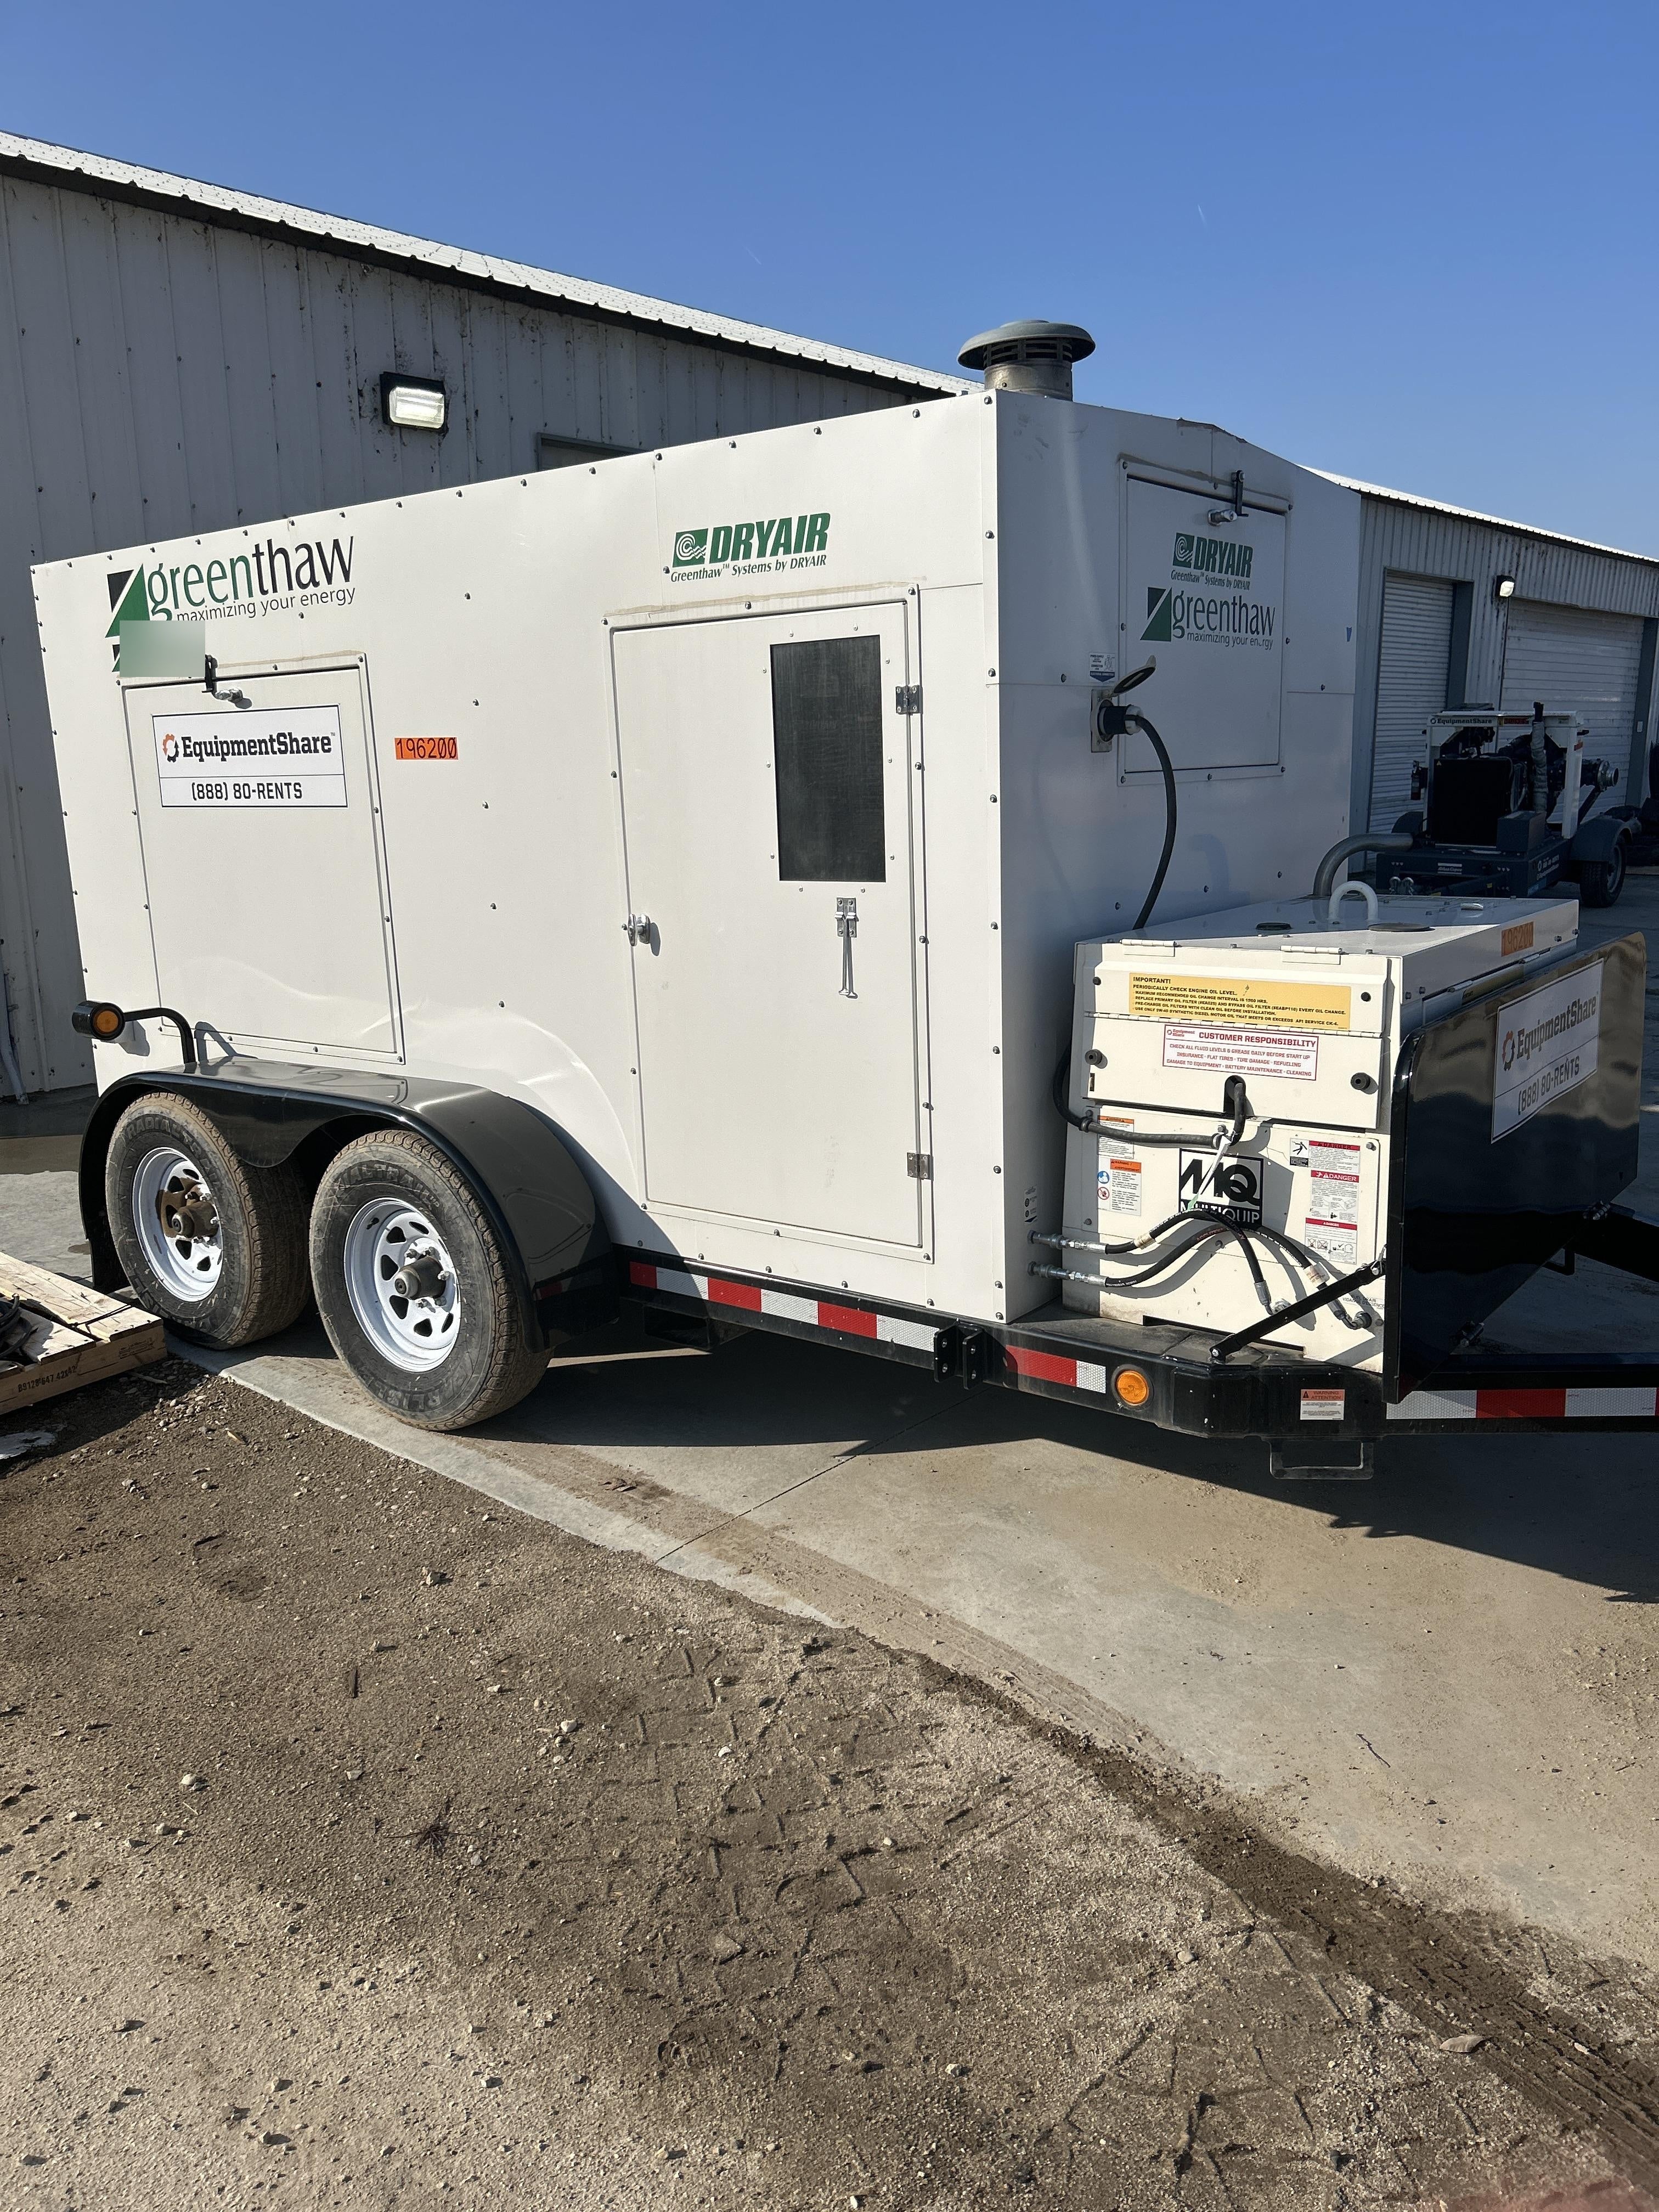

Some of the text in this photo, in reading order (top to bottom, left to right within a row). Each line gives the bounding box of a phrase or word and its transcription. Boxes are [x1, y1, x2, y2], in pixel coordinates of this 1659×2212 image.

[709, 512, 831, 564] DRYAIR
[731, 562, 772, 578] Systems
[775, 559, 788, 572] by
[789, 554, 827, 569] DRYAIR
[1193, 536, 1253, 578] DRYAIR
[146, 535, 354, 621] greenthaw
[1205, 574, 1224, 588] Systems
[1226, 578, 1232, 589] by
[1233, 580, 1250, 590] DRYAIR
[177, 586, 356, 621] maximizing your energy
[1172, 590, 1276, 639] greenthaw
[1187, 631, 1229, 647] maximizing
[1231, 635, 1248, 647] your
[397, 738, 456, 759] 196200
[191, 781, 303, 801] (888) 80-RENTS
[1199, 1032, 1316, 1047] CUSTOMER RESPONSIBILITY
[1516, 996, 1596, 1060] EquipmentShare
[1517, 1056, 1580, 1115] (888) 80-RENTS
